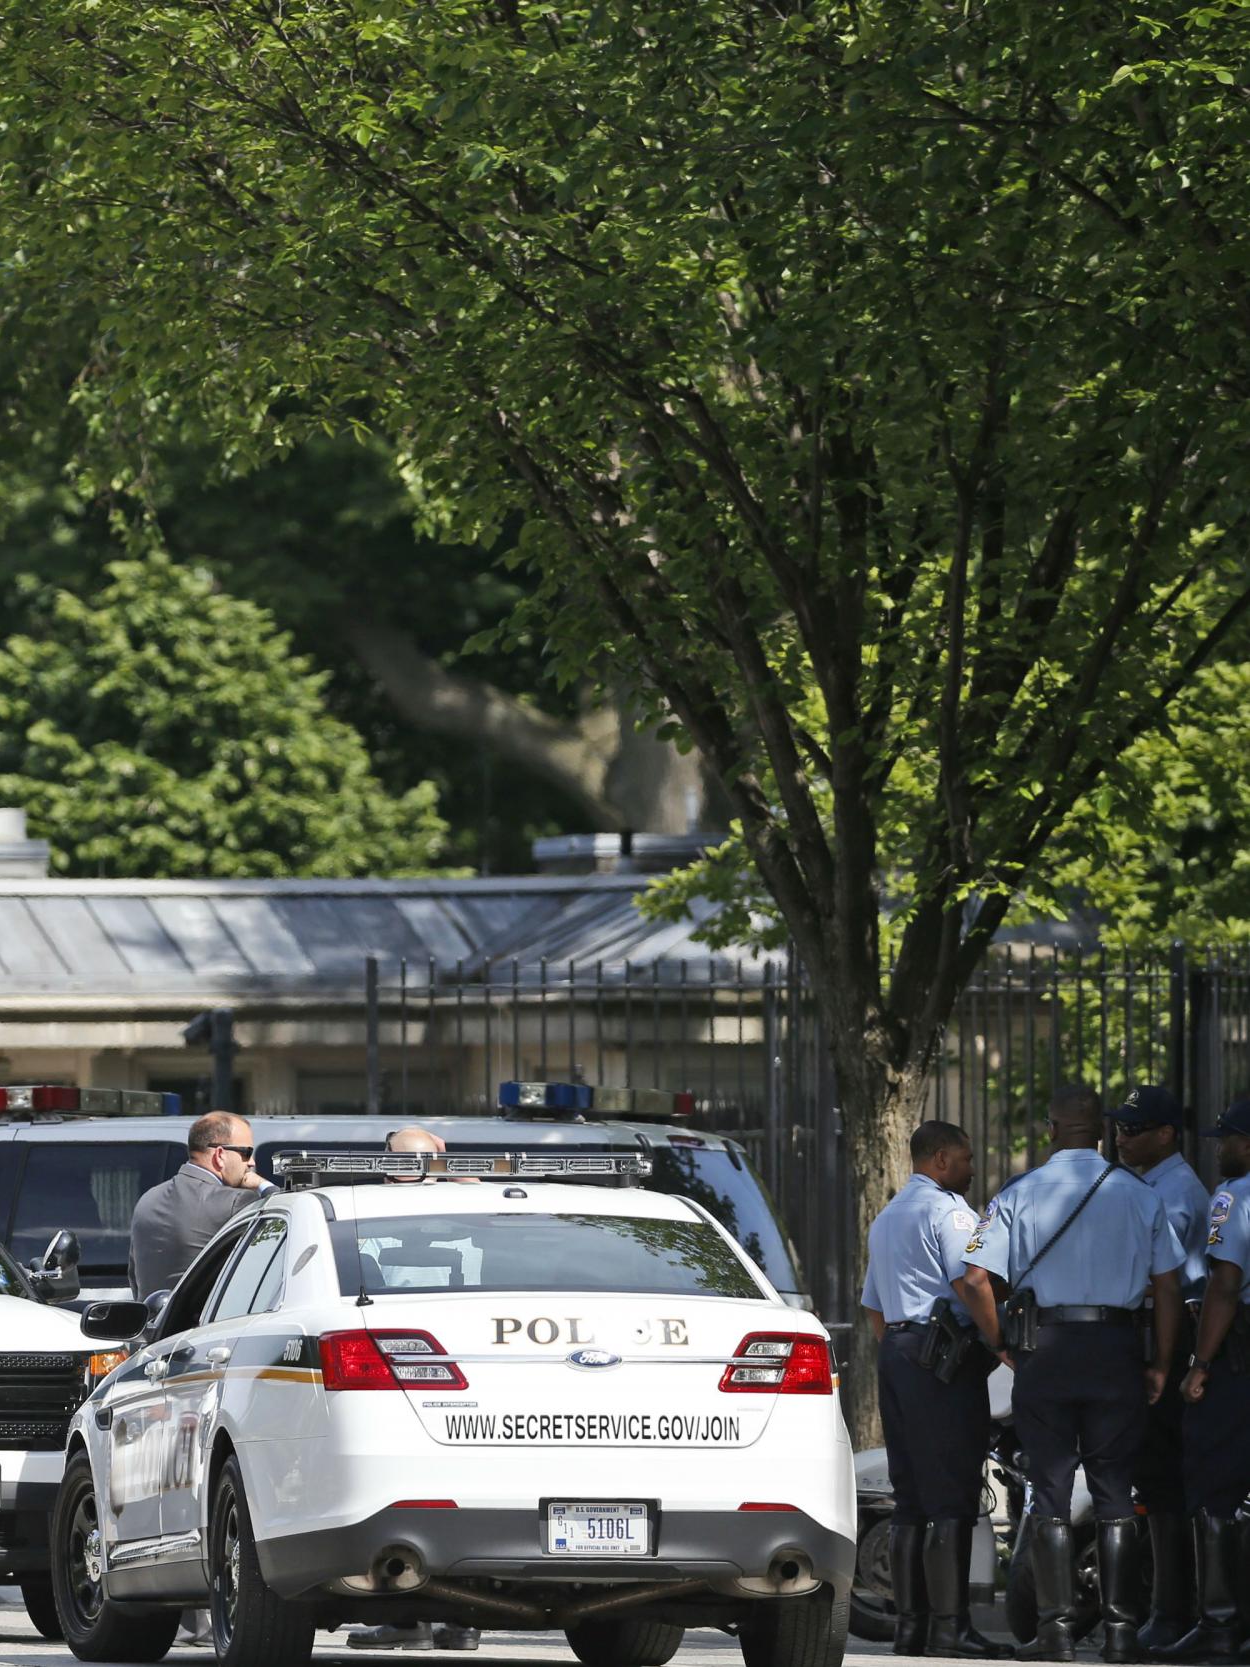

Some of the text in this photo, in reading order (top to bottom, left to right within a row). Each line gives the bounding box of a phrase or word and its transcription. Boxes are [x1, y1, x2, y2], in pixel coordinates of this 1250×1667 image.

[491, 1317, 689, 1346] POLE
[445, 1415, 740, 1441] WWW.SECRETSERVICE.GOV/JOIN
[588, 1518, 635, 1539] 5106L
